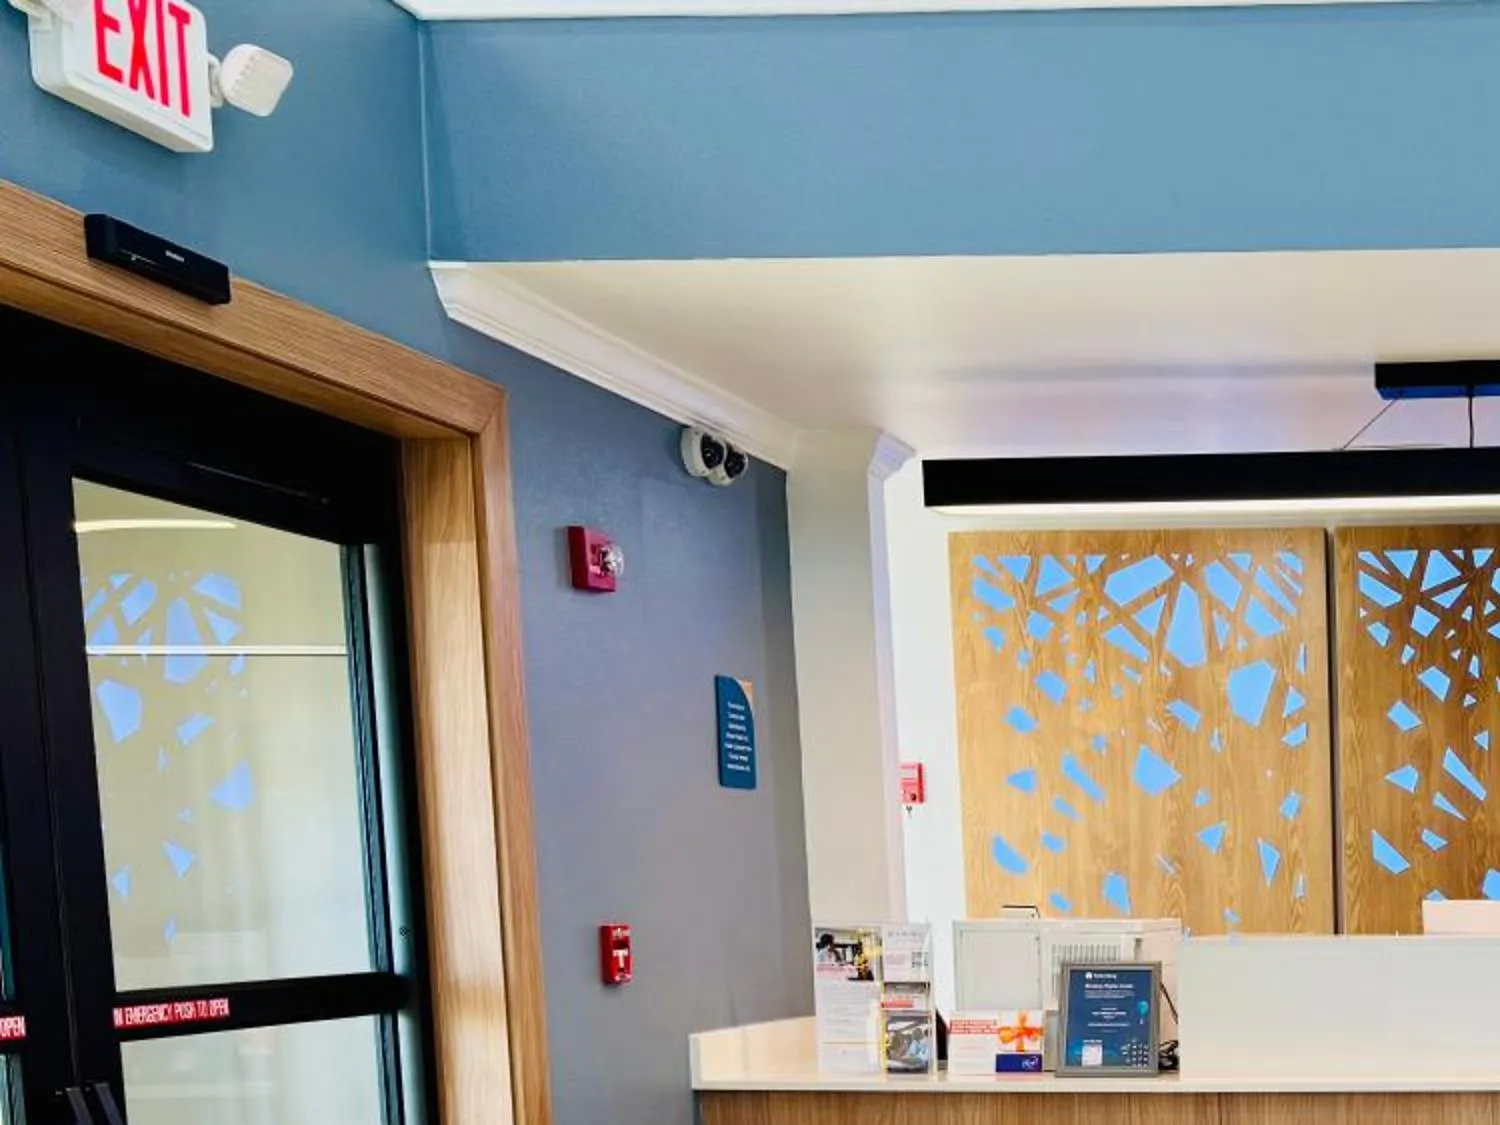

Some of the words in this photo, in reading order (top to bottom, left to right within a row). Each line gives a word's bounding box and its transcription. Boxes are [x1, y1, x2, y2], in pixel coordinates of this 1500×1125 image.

[94, 0, 190, 118] EXIT
[124, 1003, 171, 1026] EMERGENCY
[172, 1001, 195, 1020] PUSH
[208, 998, 229, 1018] OPEN
